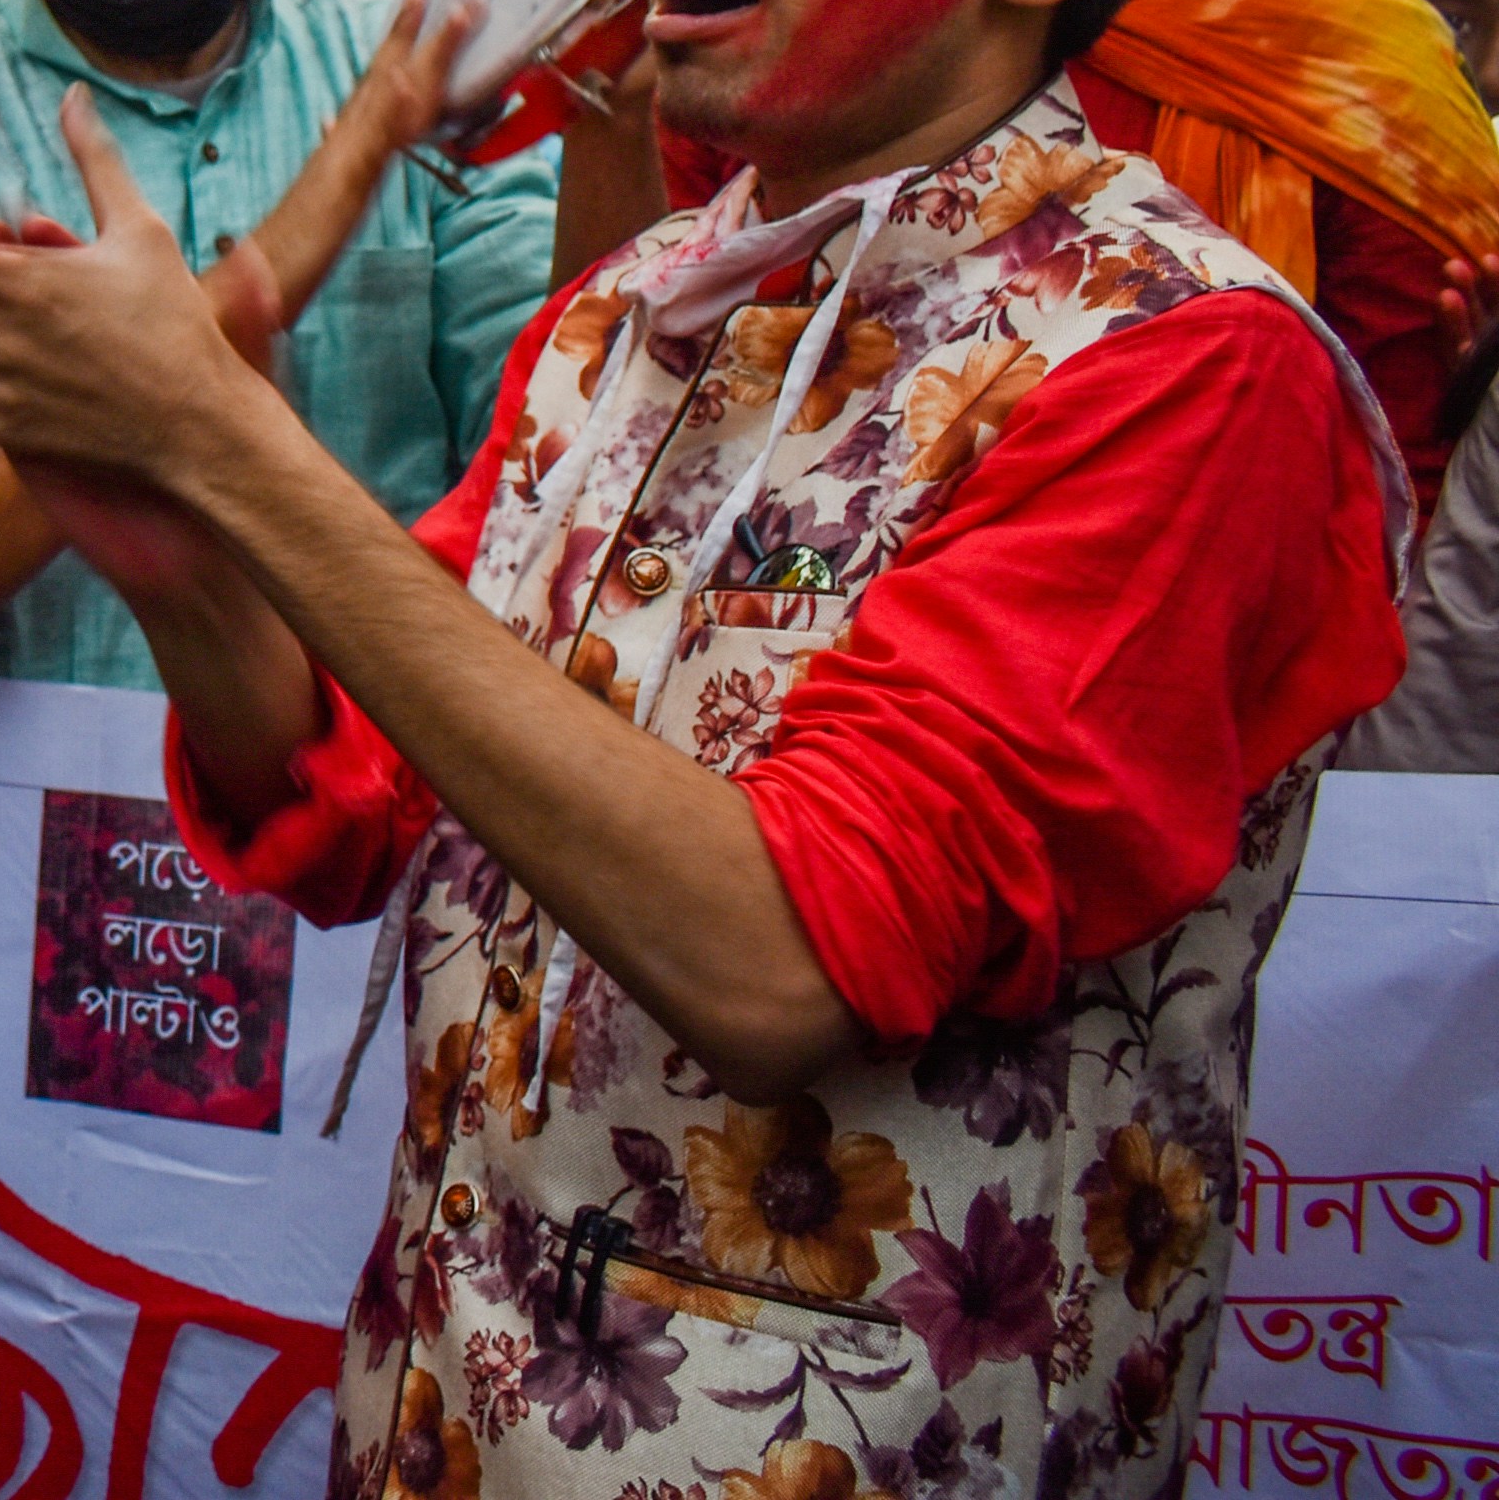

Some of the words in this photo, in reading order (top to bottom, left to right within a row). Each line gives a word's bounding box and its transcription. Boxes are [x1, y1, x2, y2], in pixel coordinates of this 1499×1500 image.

[103, 912, 225, 976] লড়ো
[77, 980, 240, 1049] পাল্টাও
[1210, 1293, 1404, 1389] তন্ত্র
